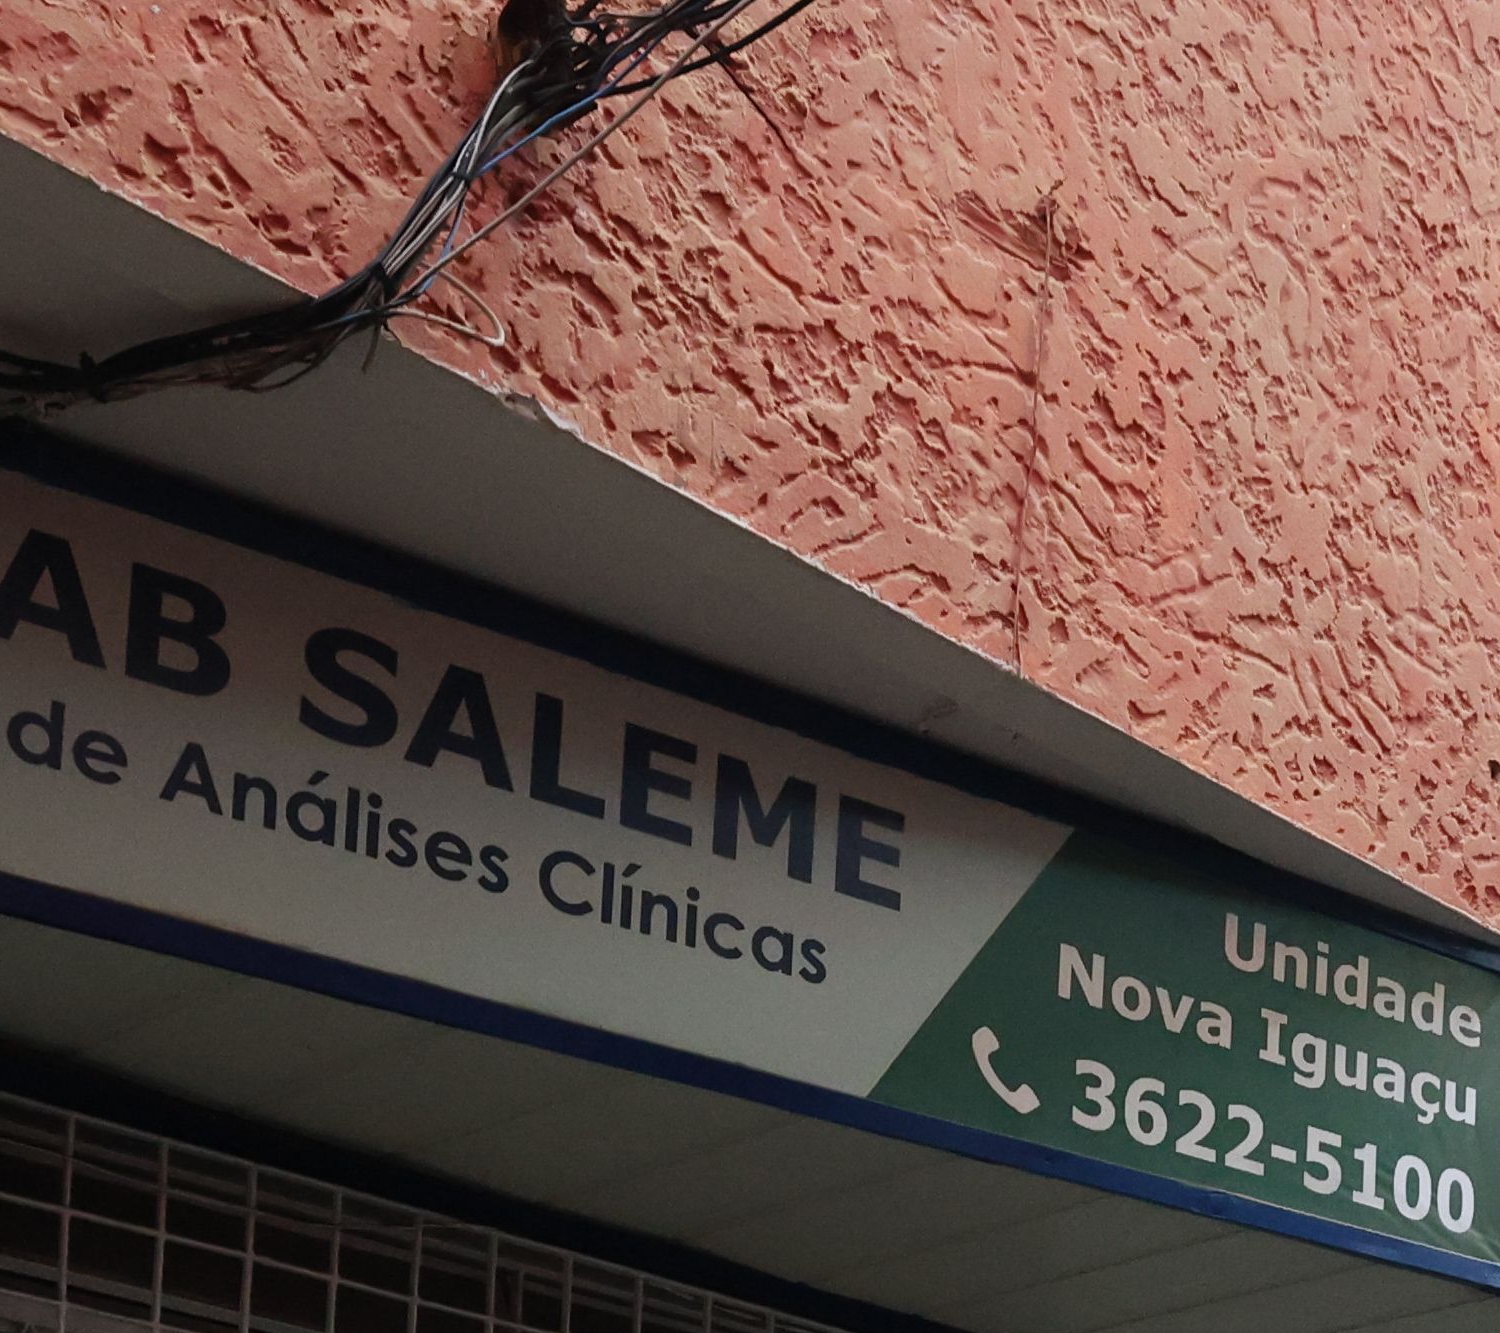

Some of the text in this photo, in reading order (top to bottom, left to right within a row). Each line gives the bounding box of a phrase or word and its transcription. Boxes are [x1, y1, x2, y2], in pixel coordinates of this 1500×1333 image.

[5, 699, 129, 787] de
[158, 741, 510, 894] Análises
[537, 849, 828, 985] Clínicas
[298, 625, 902, 913] SALEME
[1056, 942, 1477, 1126] Nova Iguaçu
[1223, 912, 1482, 1048] Unidade
[1071, 1058, 1475, 1234] 3622-5100
